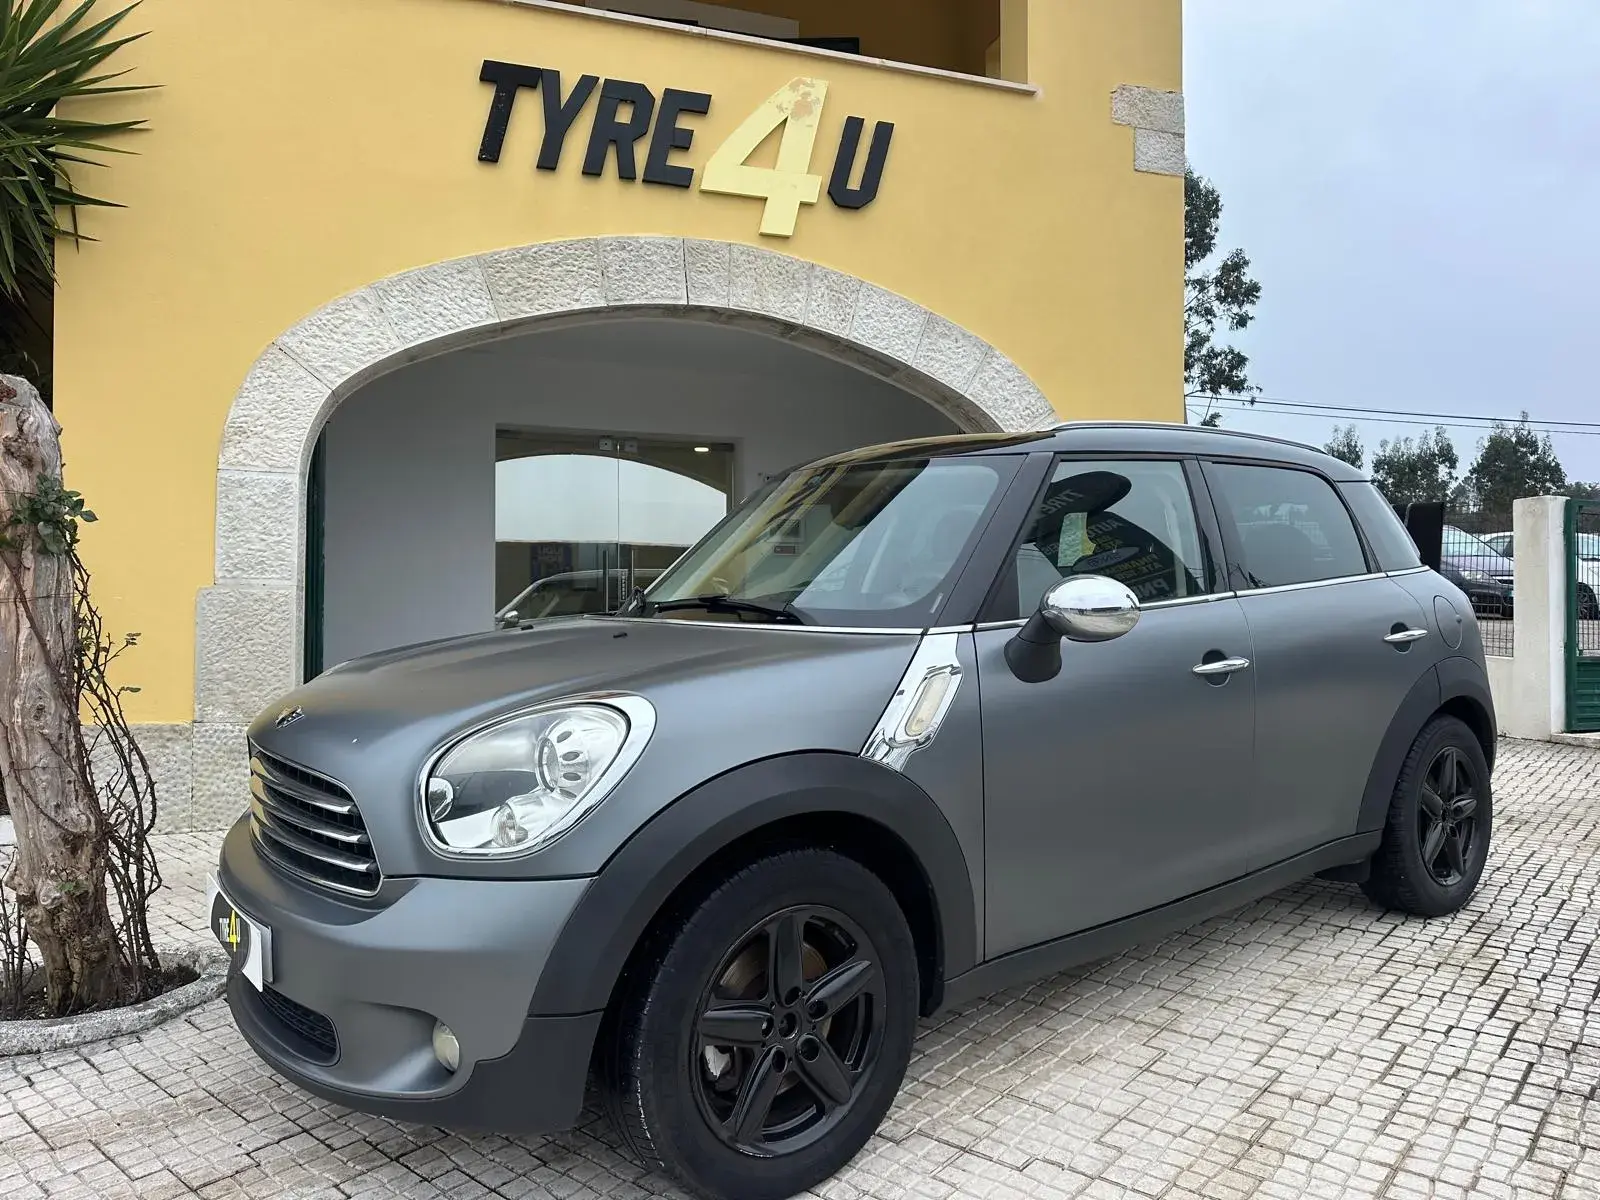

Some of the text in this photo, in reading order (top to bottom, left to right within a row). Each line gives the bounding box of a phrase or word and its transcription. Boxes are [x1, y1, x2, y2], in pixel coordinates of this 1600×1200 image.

[479, 59, 895, 237] TYRE 4 U
